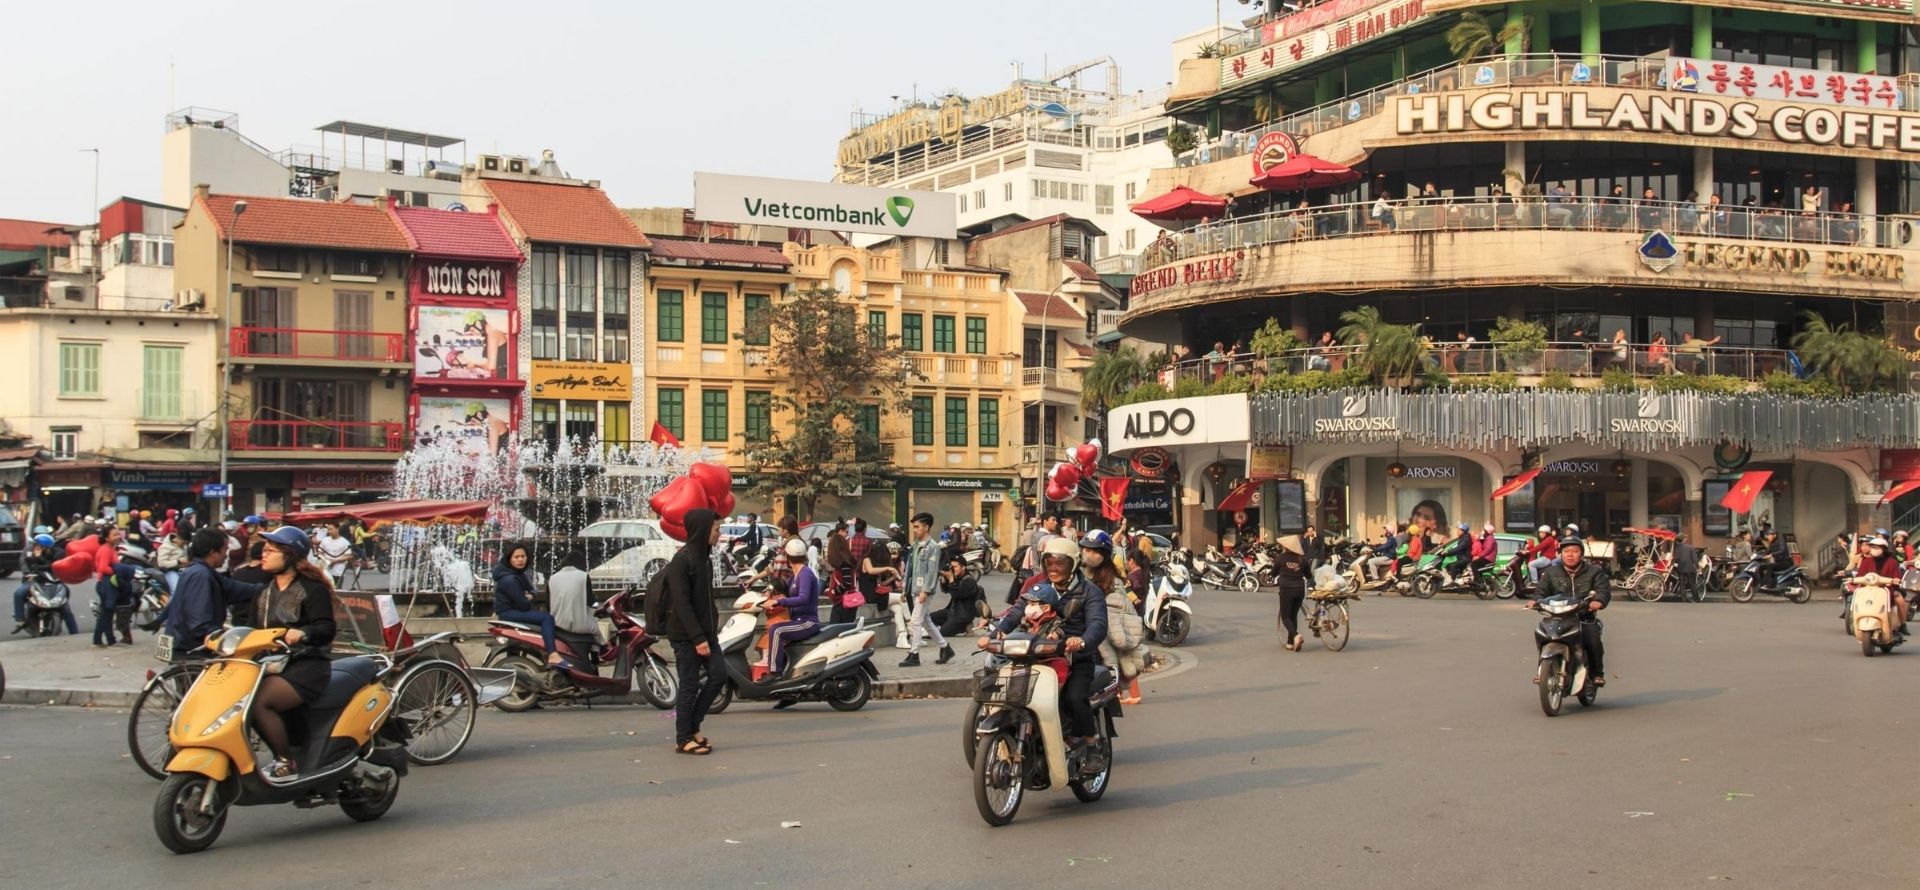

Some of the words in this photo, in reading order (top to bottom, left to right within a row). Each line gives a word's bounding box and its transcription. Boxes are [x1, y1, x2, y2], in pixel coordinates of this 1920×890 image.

[1356, 11, 1385, 41] HÀN
[1396, 91, 1760, 139] HIGHLANDS
[744, 197, 887, 226] Vietcombank
[1684, 241, 1811, 273] LEGEND
[1825, 250, 1905, 280] BEER
[427, 262, 463, 294] NÓN
[466, 266, 502, 296] SƠN
[1130, 267, 1177, 297] LEGEND
[1183, 256, 1237, 285] BEER
[1123, 407, 1195, 439] ALDO
[1315, 416, 1396, 432] SWAROVSKI
[1611, 418, 1685, 433] SWAROVSKI
[111, 471, 145, 483] Vinh
[307, 473, 357, 485] Leather
[937, 479, 983, 488] Vietcombank
[1401, 467, 1455, 478] AROVSKI
